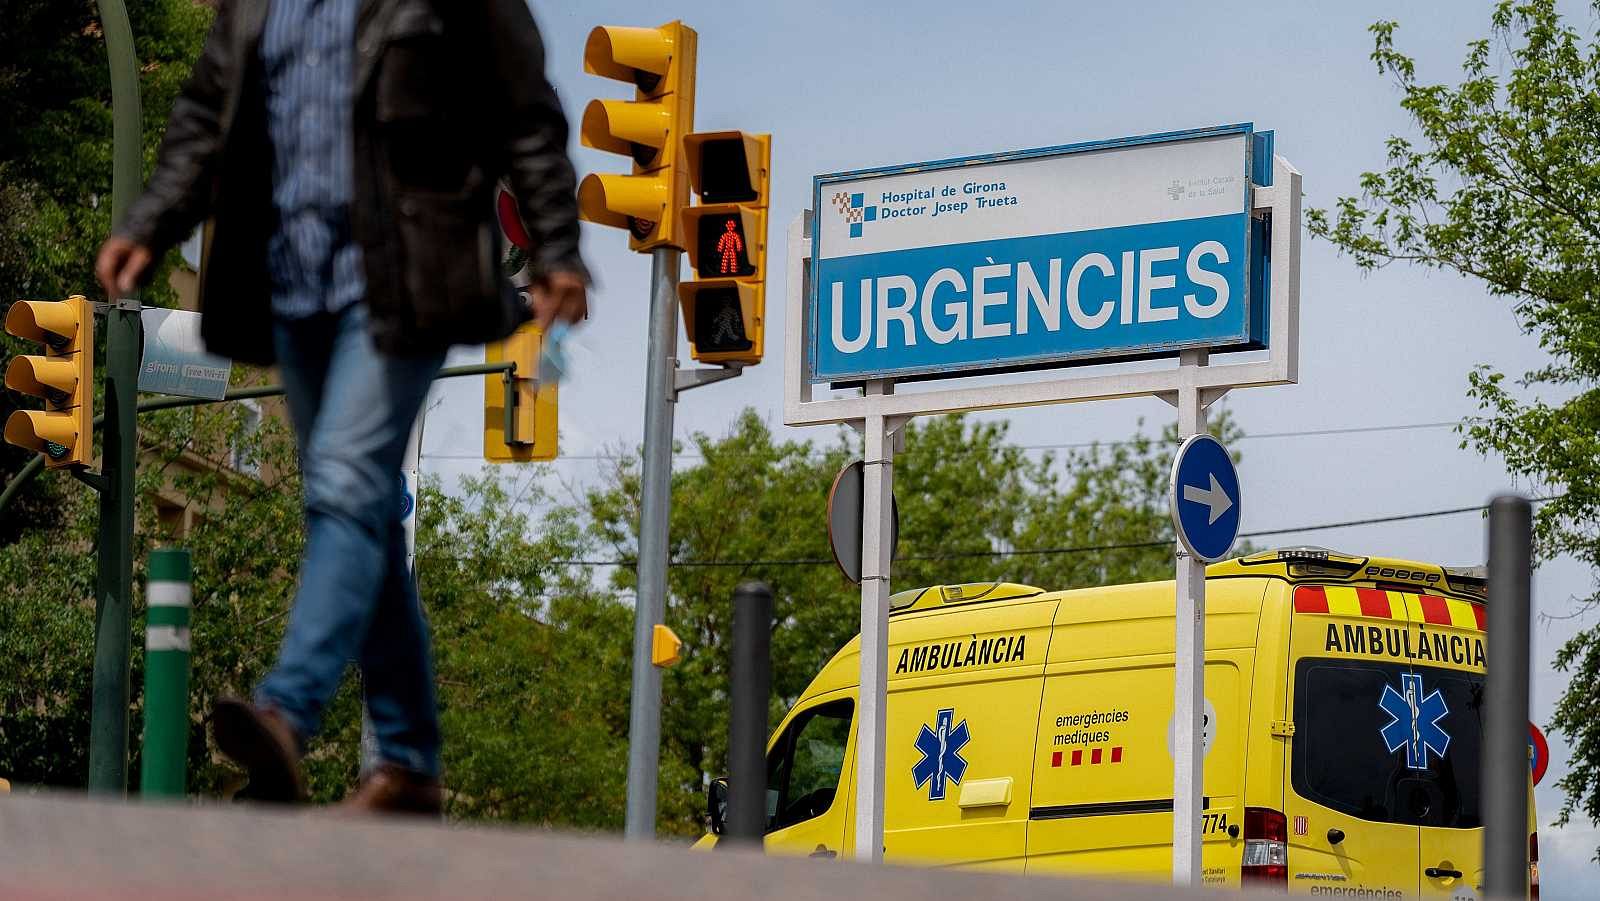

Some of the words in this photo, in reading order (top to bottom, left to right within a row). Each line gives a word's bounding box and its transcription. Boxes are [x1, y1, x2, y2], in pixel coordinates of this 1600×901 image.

[882, 187, 935, 204] Hospital
[941, 185, 956, 197] de
[963, 182, 1006, 194] Girona
[881, 206, 926, 219] Doctor
[932, 201, 968, 217] Josep
[975, 196, 1018, 208] Trueta
[831, 240, 1230, 354] URGÈNCIES
[895, 634, 1027, 674] AMBULÀNCIA
[1325, 623, 1487, 668] AMBULÀNCIA
[1056, 708, 1129, 728] emergències
[1053, 730, 1109, 746] mediques
